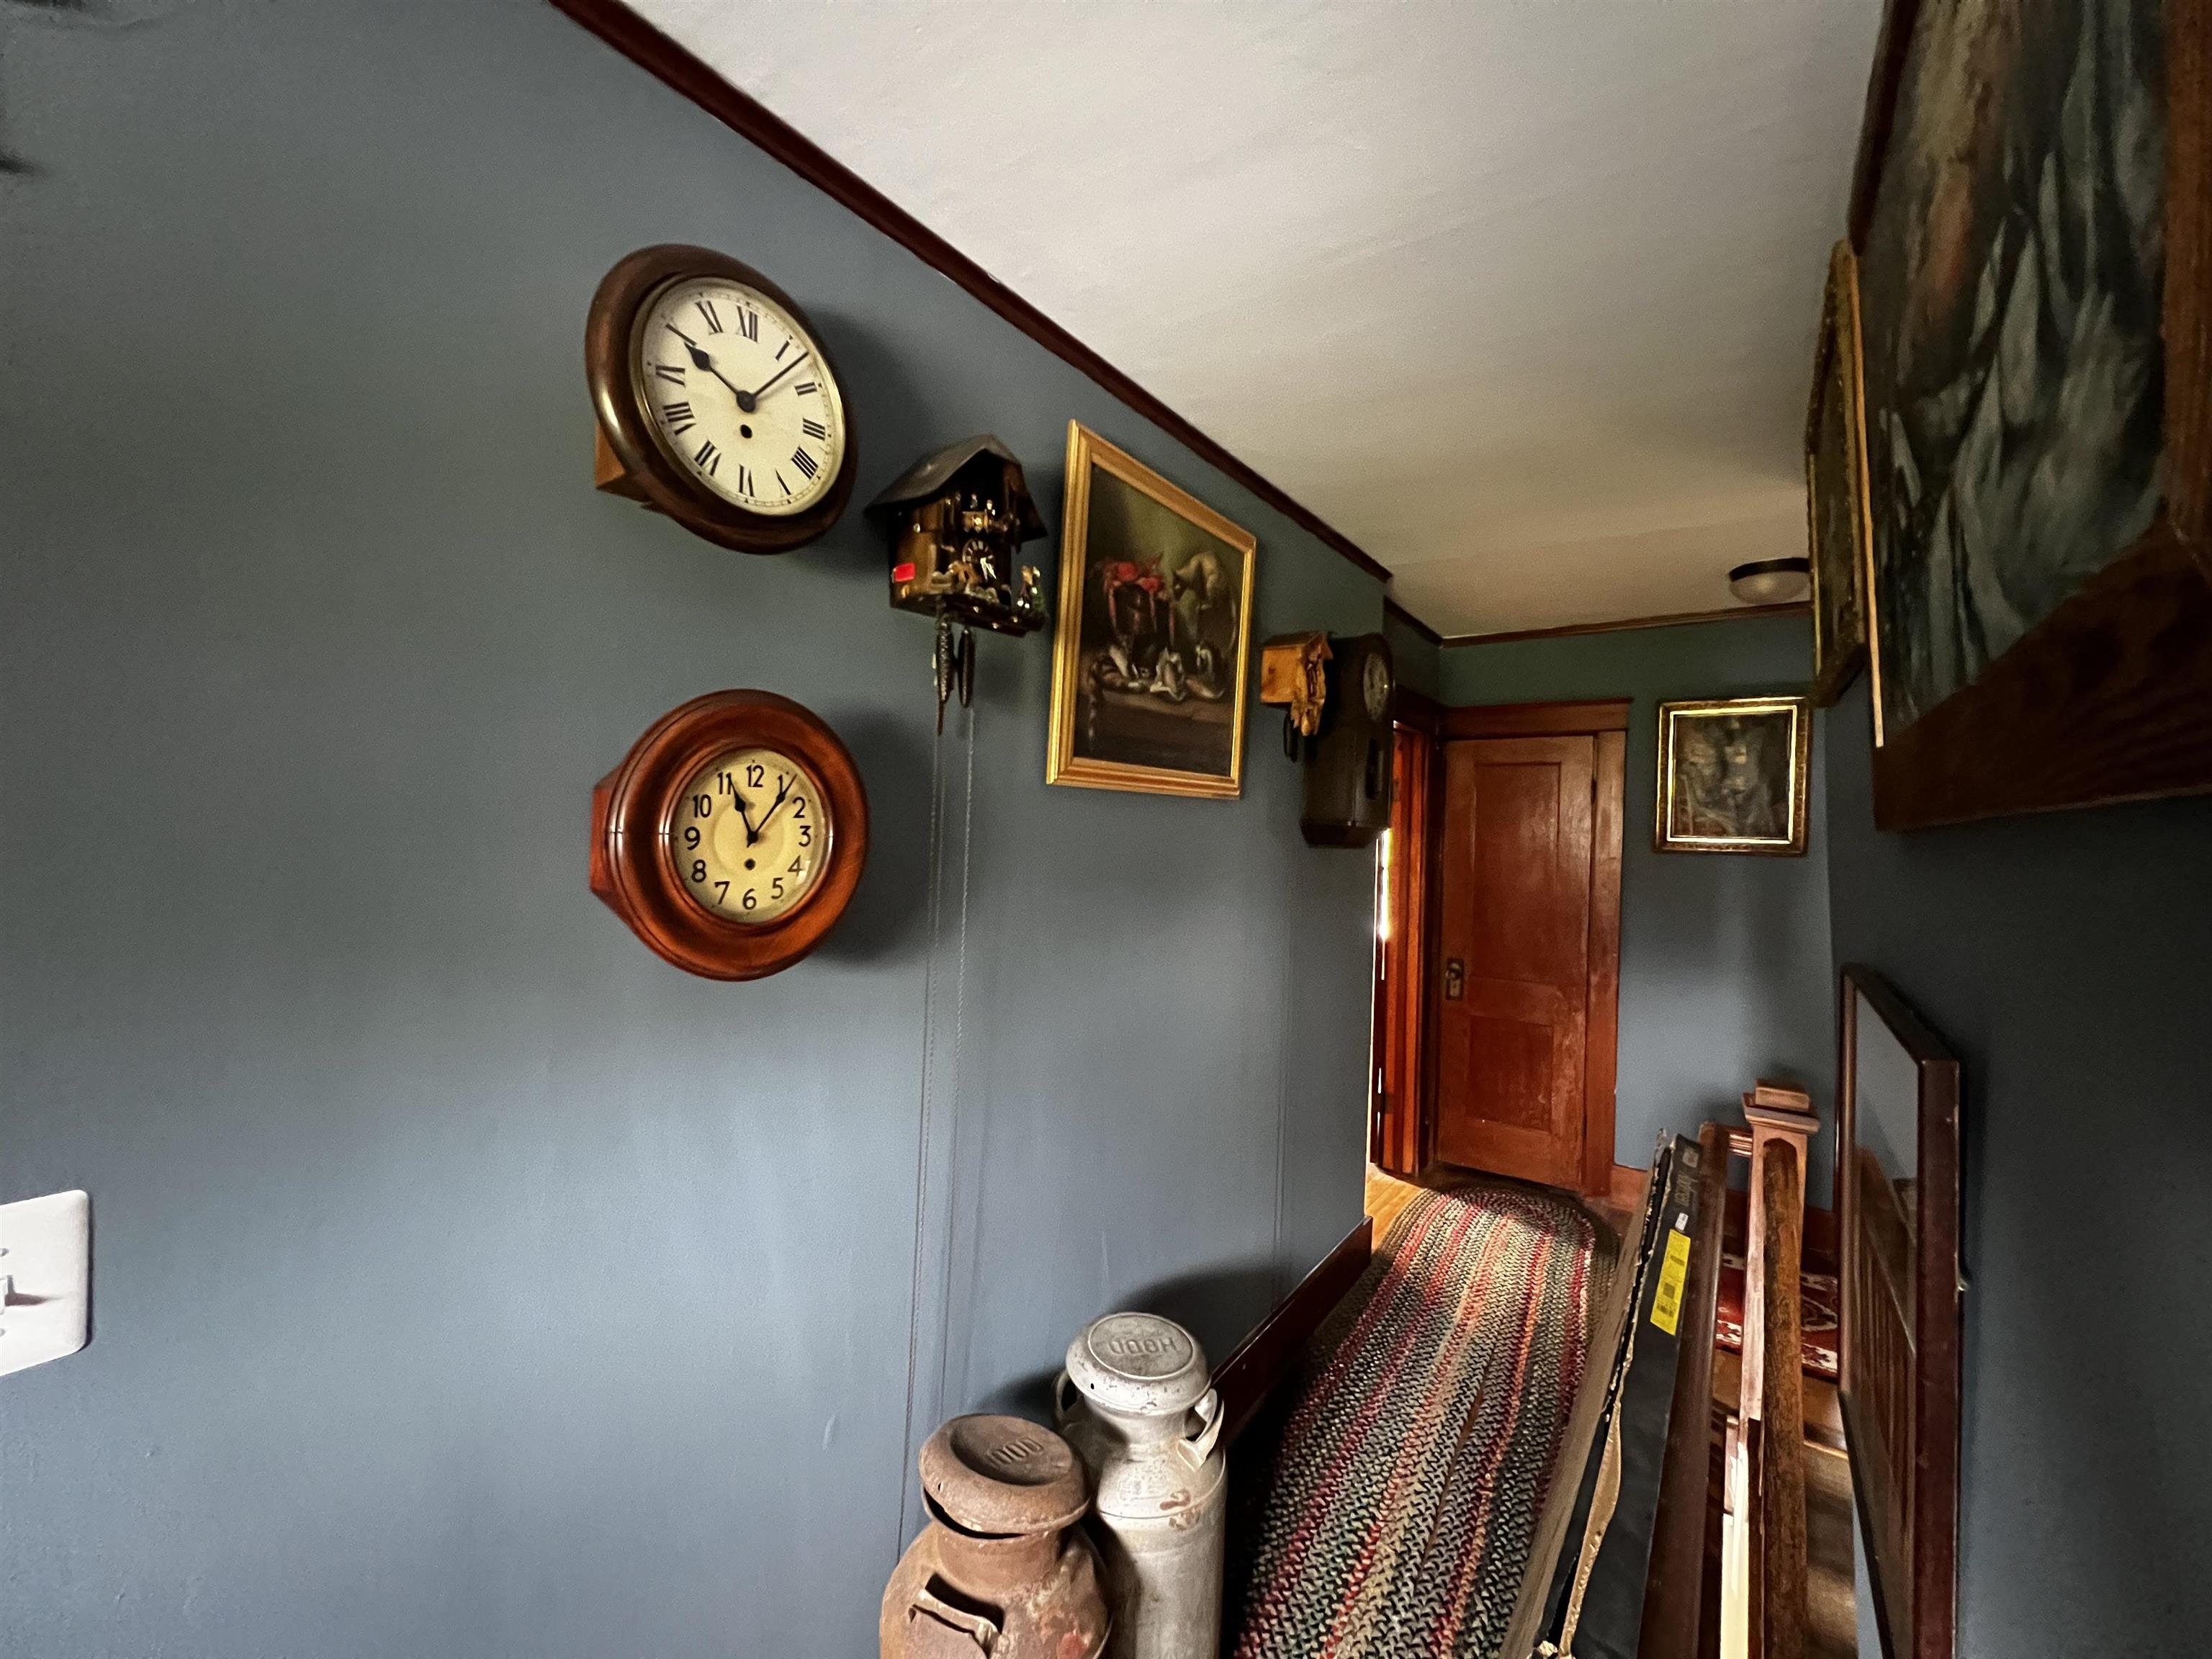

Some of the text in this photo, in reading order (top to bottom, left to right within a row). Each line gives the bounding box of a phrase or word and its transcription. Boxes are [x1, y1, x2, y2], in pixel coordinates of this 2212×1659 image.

[694, 300, 724, 336] XI
[735, 305, 758, 343] XII
[655, 364, 685, 387] IX
[794, 381, 817, 396] II
[662, 401, 696, 436] VIII
[802, 417, 825, 441] III
[694, 439, 721, 476] VII
[717, 771, 732, 795] 11
[746, 765, 765, 788] 12
[693, 793, 712, 818] 10
[792, 796, 806, 819] 2
[684, 826, 701, 850] 9
[798, 824, 812, 848] 3
[691, 859, 707, 884] 8
[787, 854, 804, 877] 4
[714, 880, 730, 905] 7
[742, 888, 757, 910] 6
[771, 877, 784, 899] 5
[1108, 1336, 1177, 1354] HOOD
